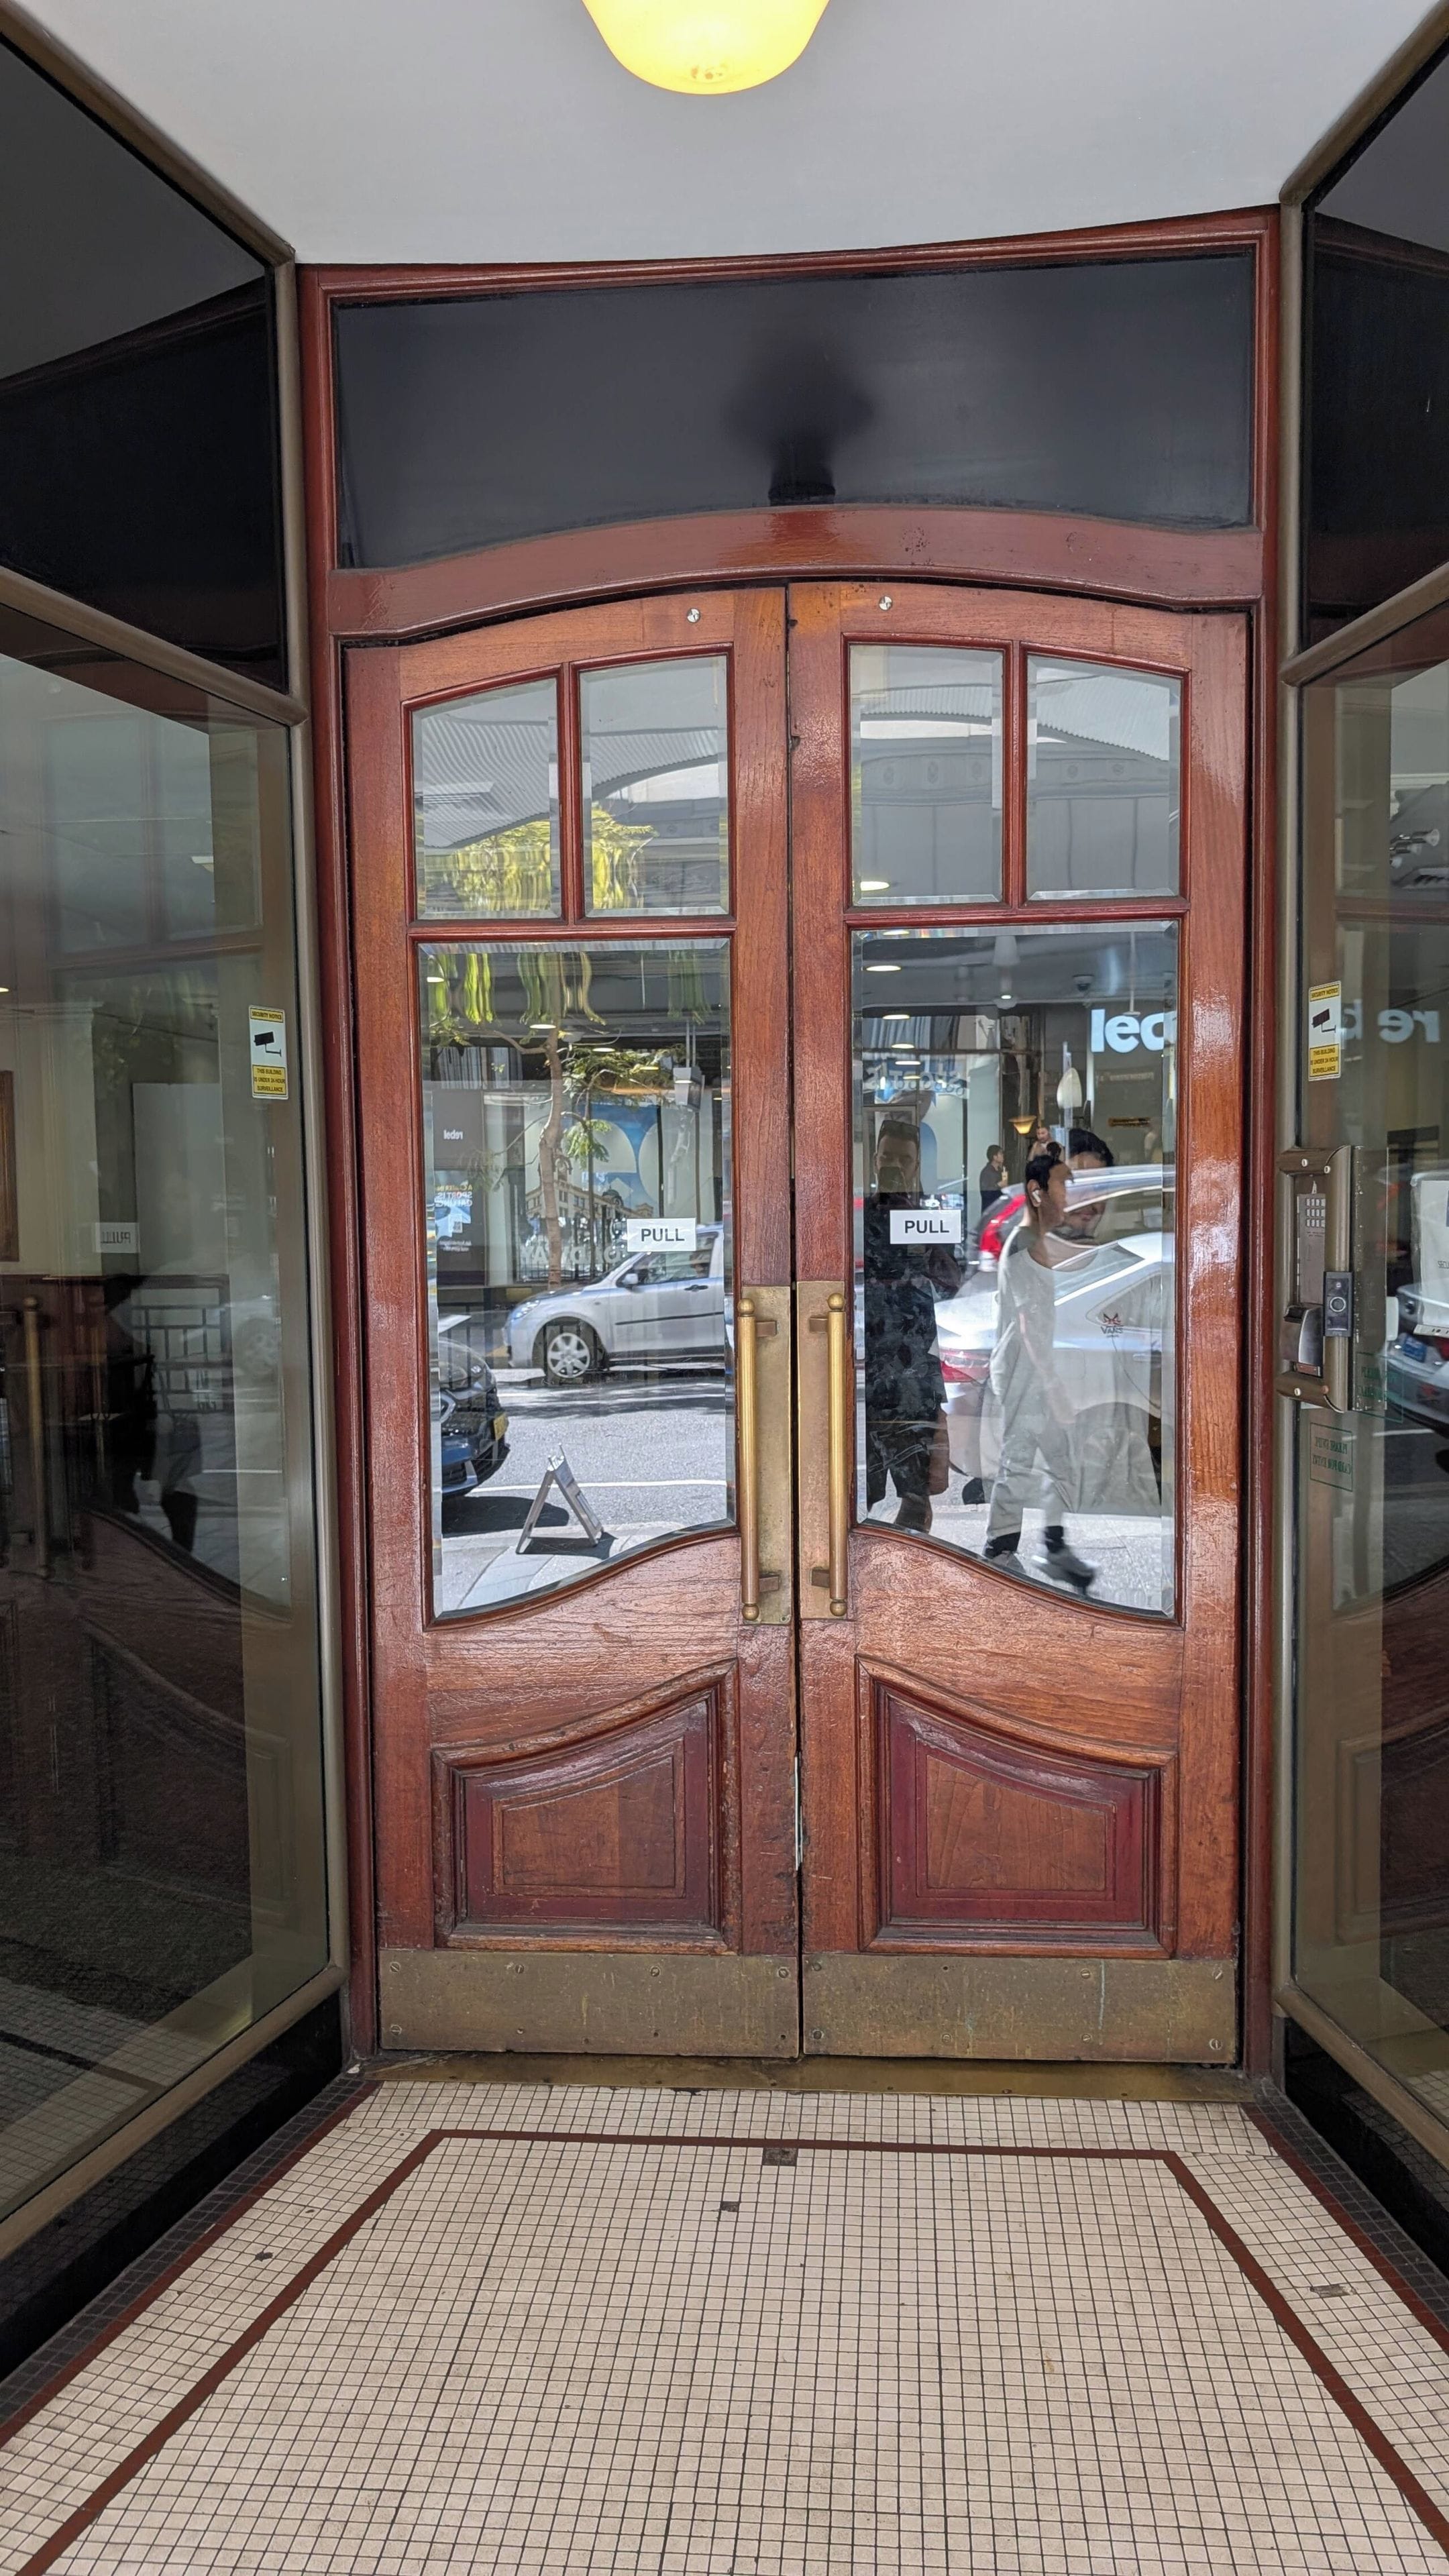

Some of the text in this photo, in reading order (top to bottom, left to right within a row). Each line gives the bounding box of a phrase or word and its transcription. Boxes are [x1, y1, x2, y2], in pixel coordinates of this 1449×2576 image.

[1311, 989, 1326, 998] SECURITY
[252, 1011, 268, 1019] SECURITY
[1312, 1065, 1336, 1074] SURVEILLANCE
[904, 1220, 950, 1234] PULL
[641, 1228, 685, 1242] PULL
[1101, 1326, 1124, 1334] VANS
